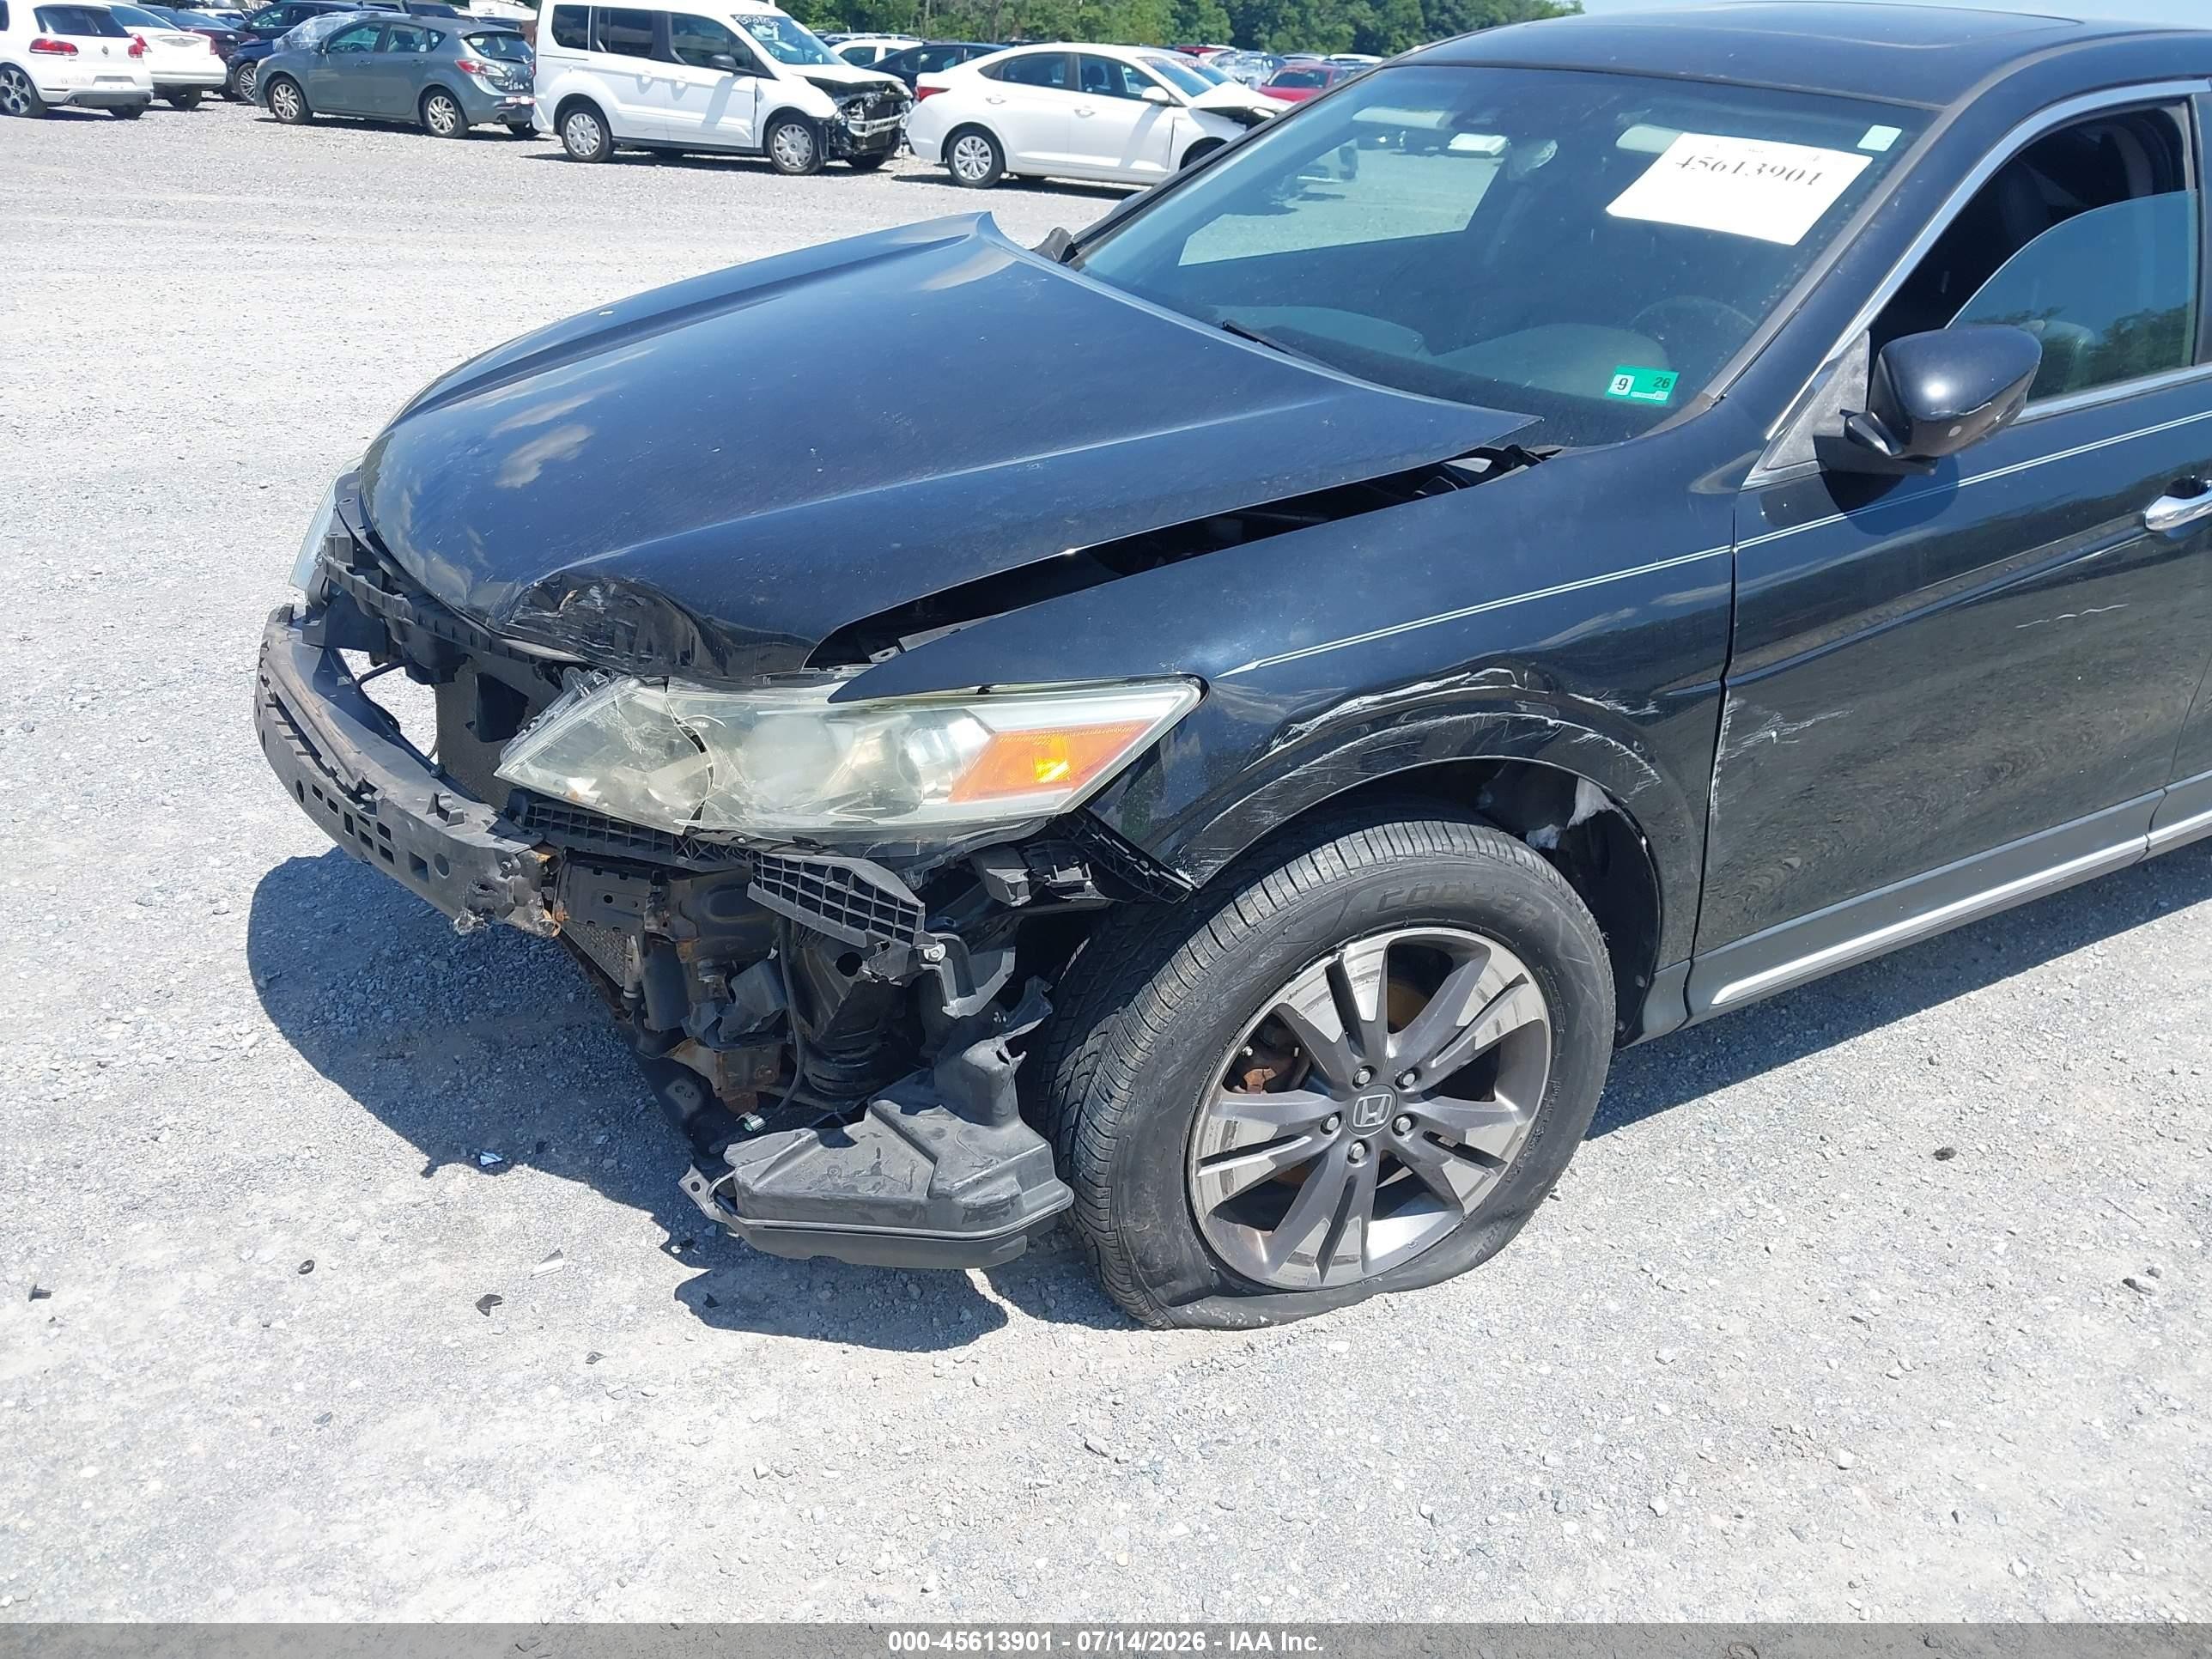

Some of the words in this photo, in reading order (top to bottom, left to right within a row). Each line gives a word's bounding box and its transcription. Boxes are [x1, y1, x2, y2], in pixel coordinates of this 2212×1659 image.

[1675, 155, 1824, 185] 45613901
[1616, 377, 1629, 391] 9
[1653, 376, 1671, 389] 26
